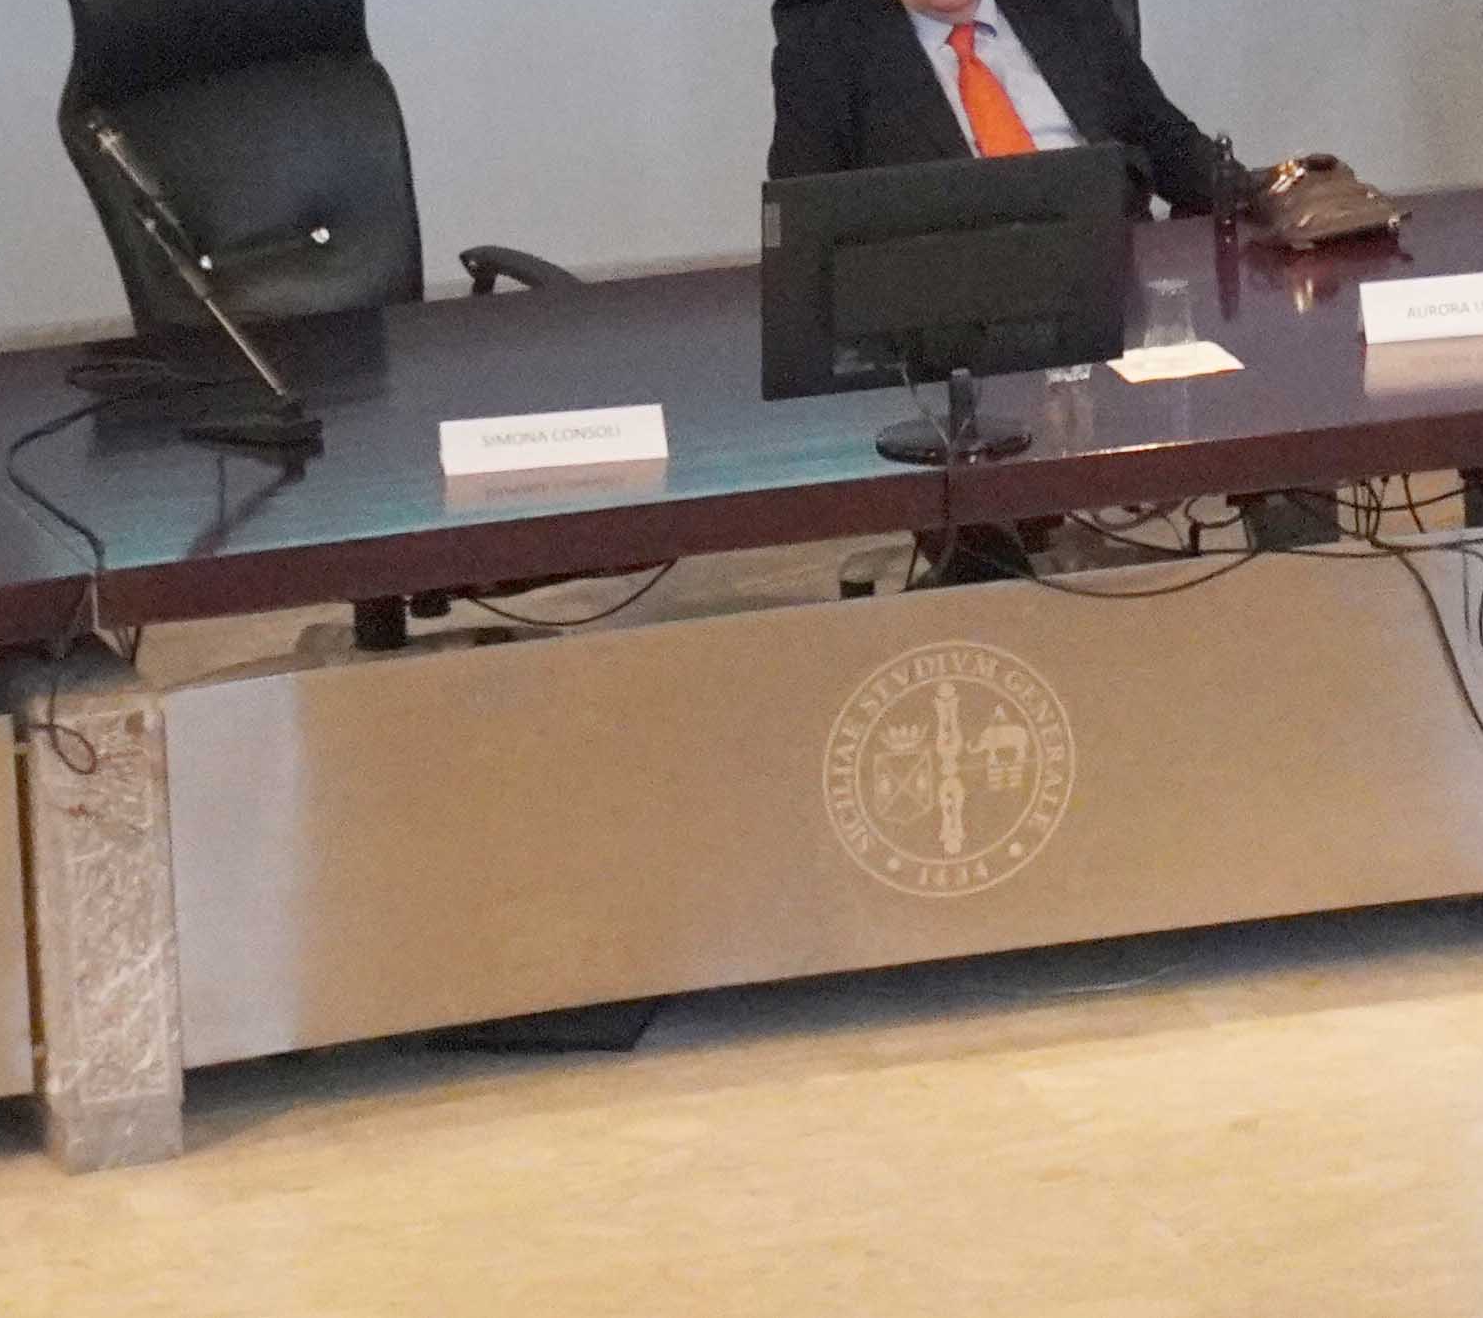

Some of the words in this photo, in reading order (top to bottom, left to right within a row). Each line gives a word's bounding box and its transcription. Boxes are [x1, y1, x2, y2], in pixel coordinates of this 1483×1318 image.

[1407, 301, 1470, 319] AURORA
[480, 430, 546, 447] SIMONA
[549, 424, 621, 443] CONSOLI
